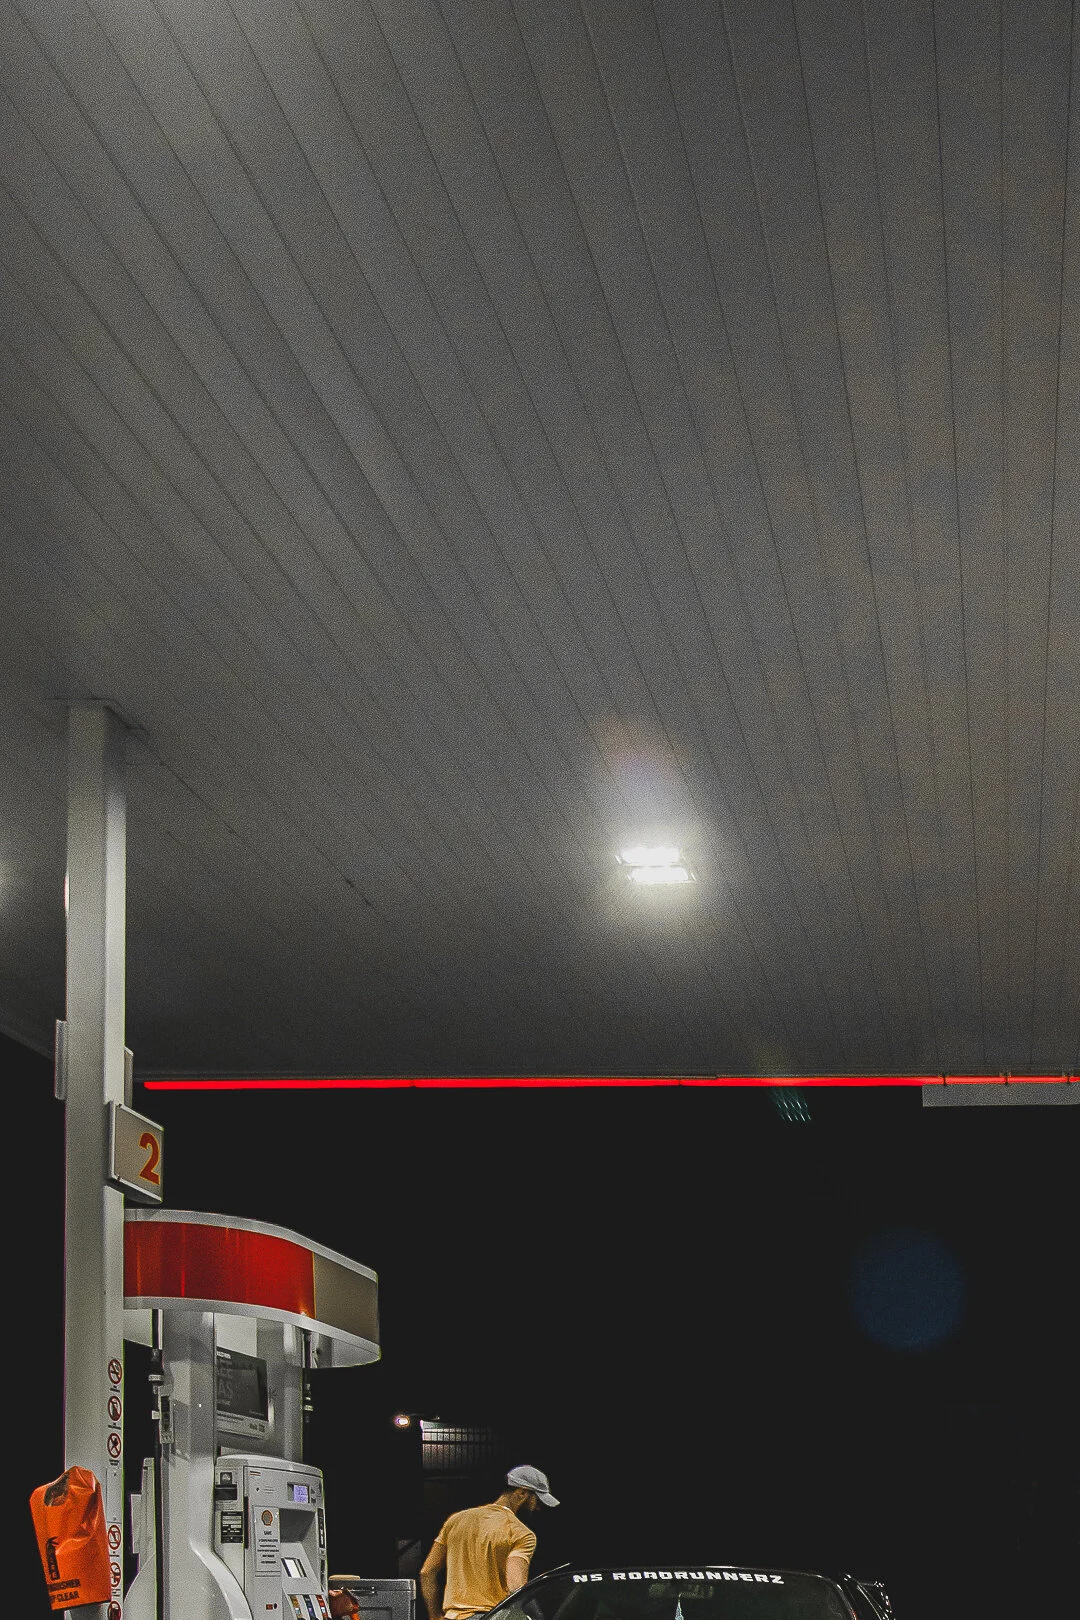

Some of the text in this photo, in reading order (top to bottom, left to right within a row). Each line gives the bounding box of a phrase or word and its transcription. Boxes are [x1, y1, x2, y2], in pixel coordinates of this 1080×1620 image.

[139, 1132, 160, 1185] 2
[573, 1571, 785, 1585] NS ROADRUNNERZ
[57, 1590, 80, 1602] CLEAR
